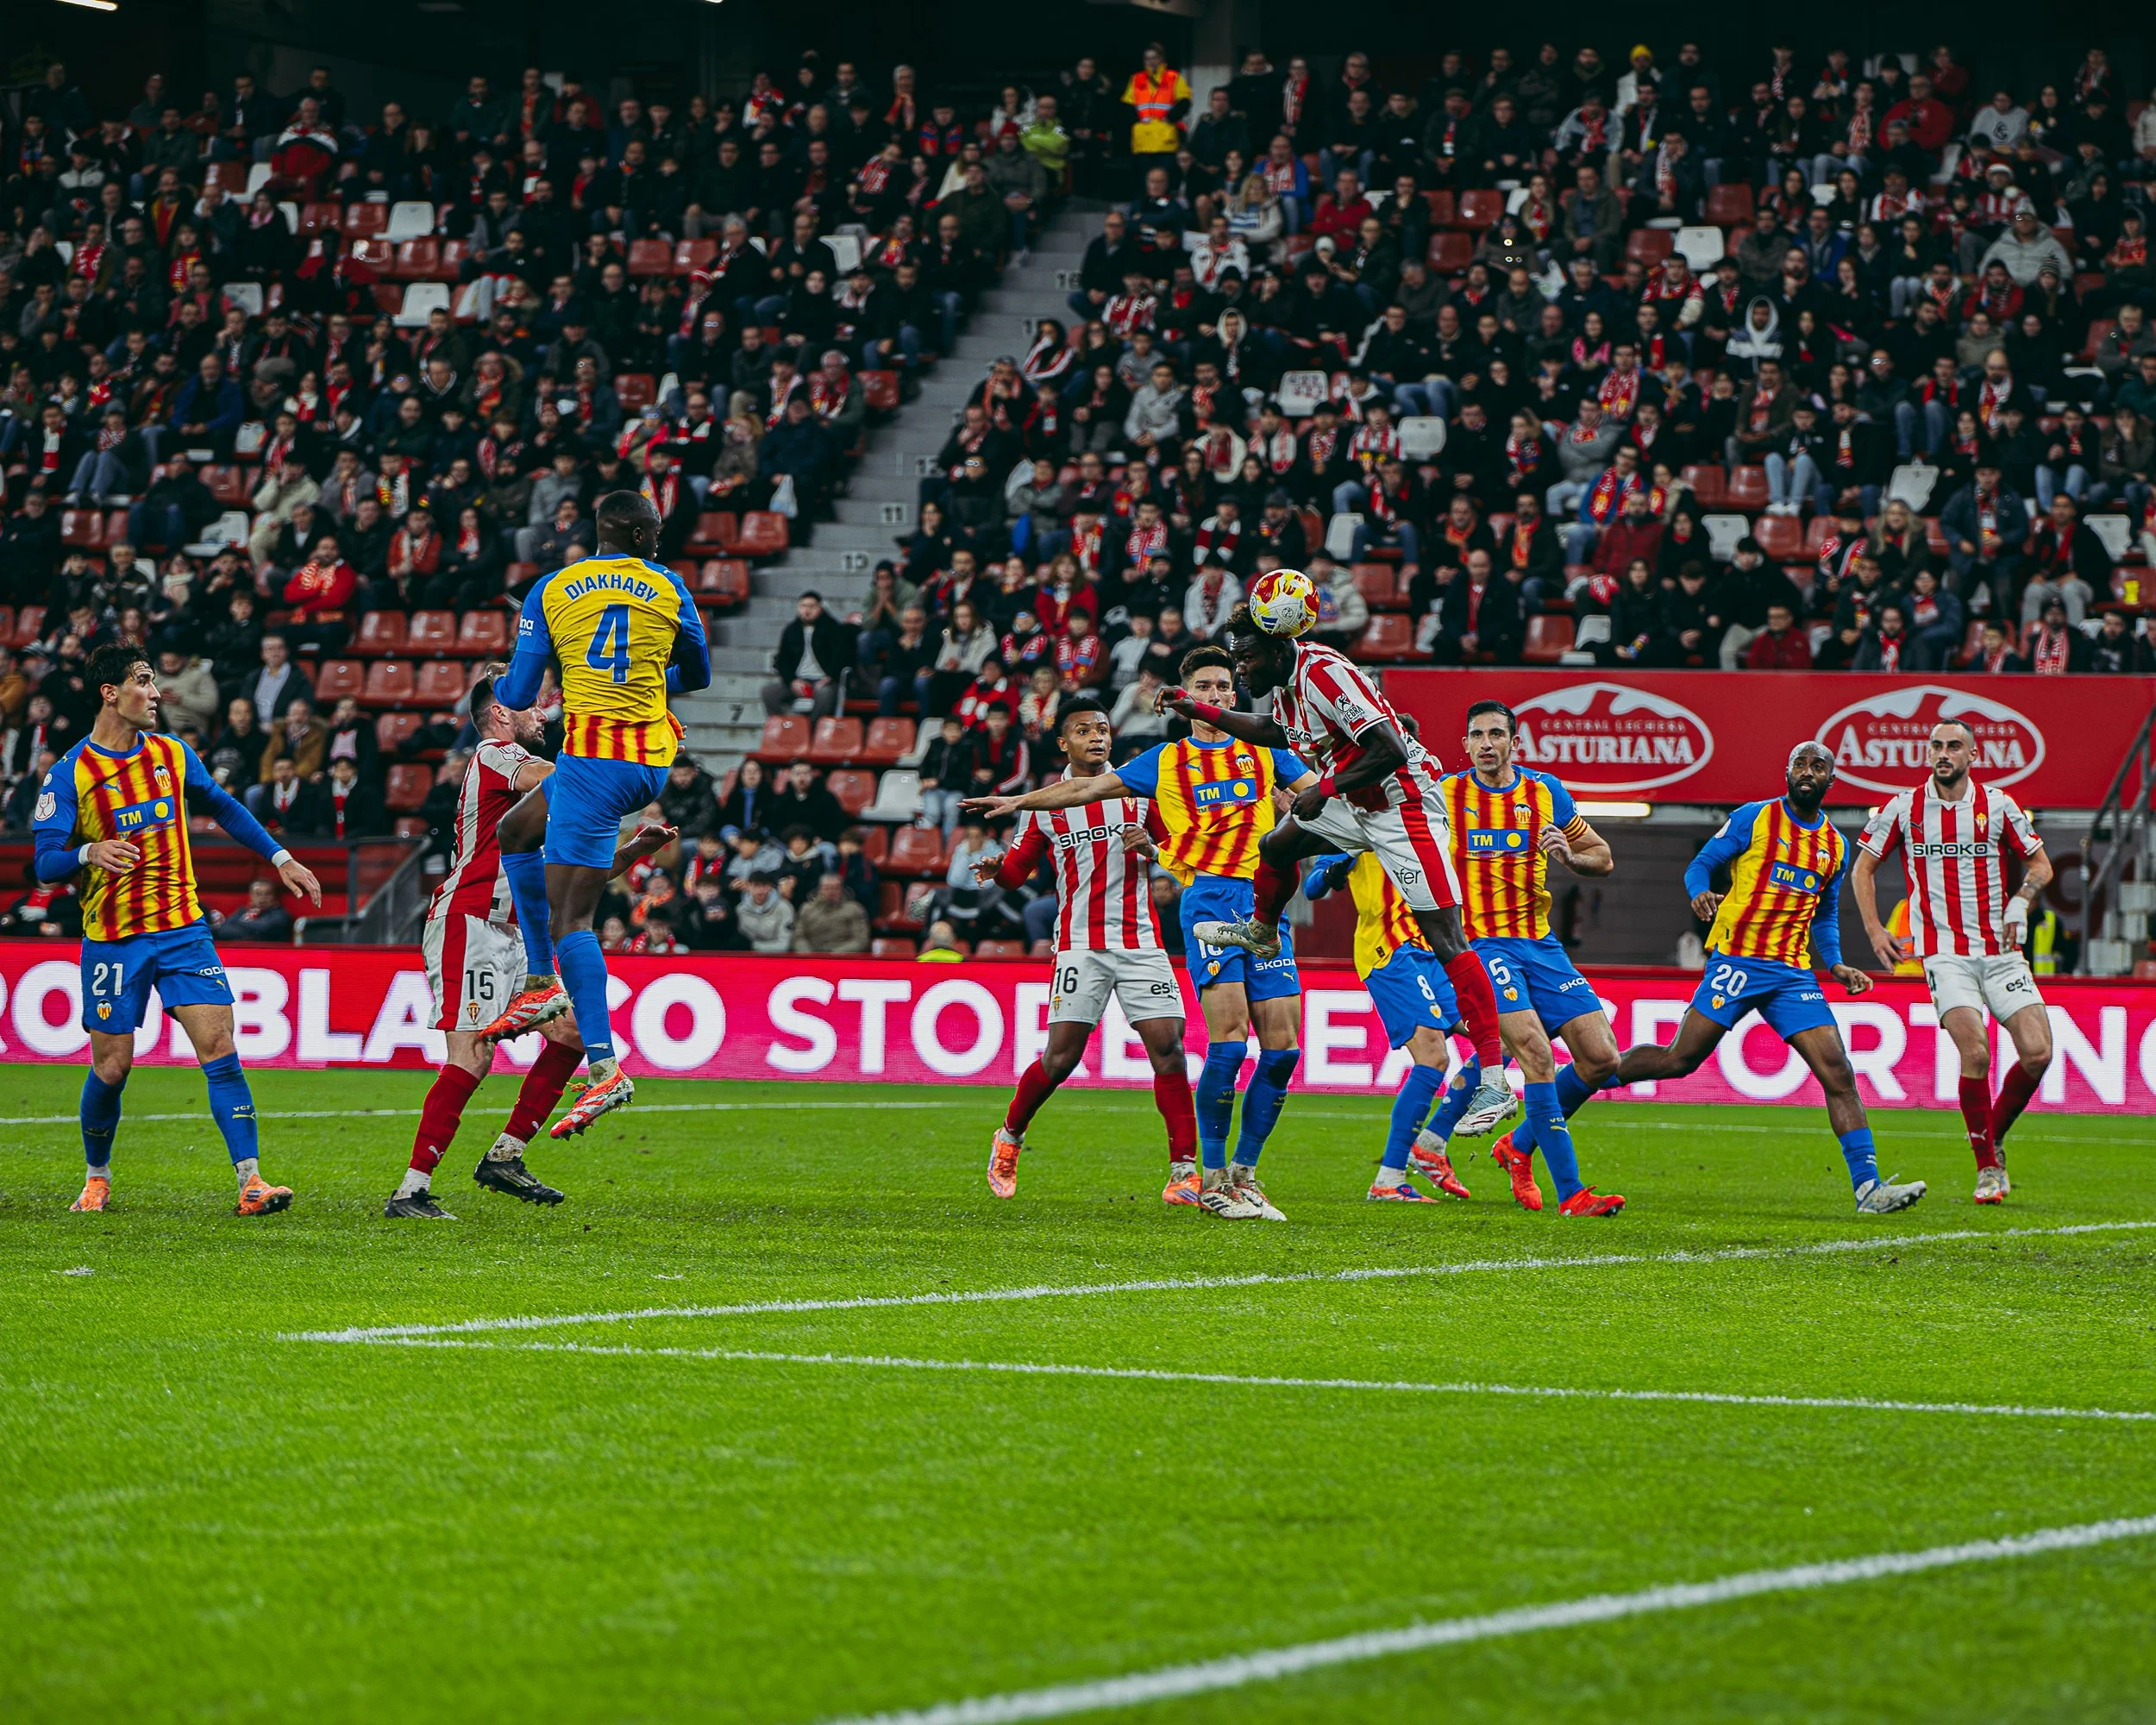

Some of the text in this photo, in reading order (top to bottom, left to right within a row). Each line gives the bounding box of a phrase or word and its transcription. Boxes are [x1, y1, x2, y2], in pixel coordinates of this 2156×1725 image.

[564, 574, 659, 604] DIAKHABY
[585, 603, 631, 684] 4
[730, 703, 744, 724] 7
[1540, 718, 1610, 732] CENTRAL
[1867, 721, 1933, 734] CENTRA
[1509, 720, 1696, 765] ASTURIANA
[1198, 787, 1220, 801] TM
[118, 810, 142, 827] TM
[1471, 834, 1494, 847] TM
[1913, 844, 1988, 856] SIROKO
[1777, 867, 1796, 882] TM
[91, 963, 123, 995] 21
[1055, 966, 1078, 994] 16
[1488, 957, 1511, 985] 5
[1711, 963, 1747, 996] 20
[466, 969, 494, 1000] 15
[1417, 975, 1436, 1000] 8
